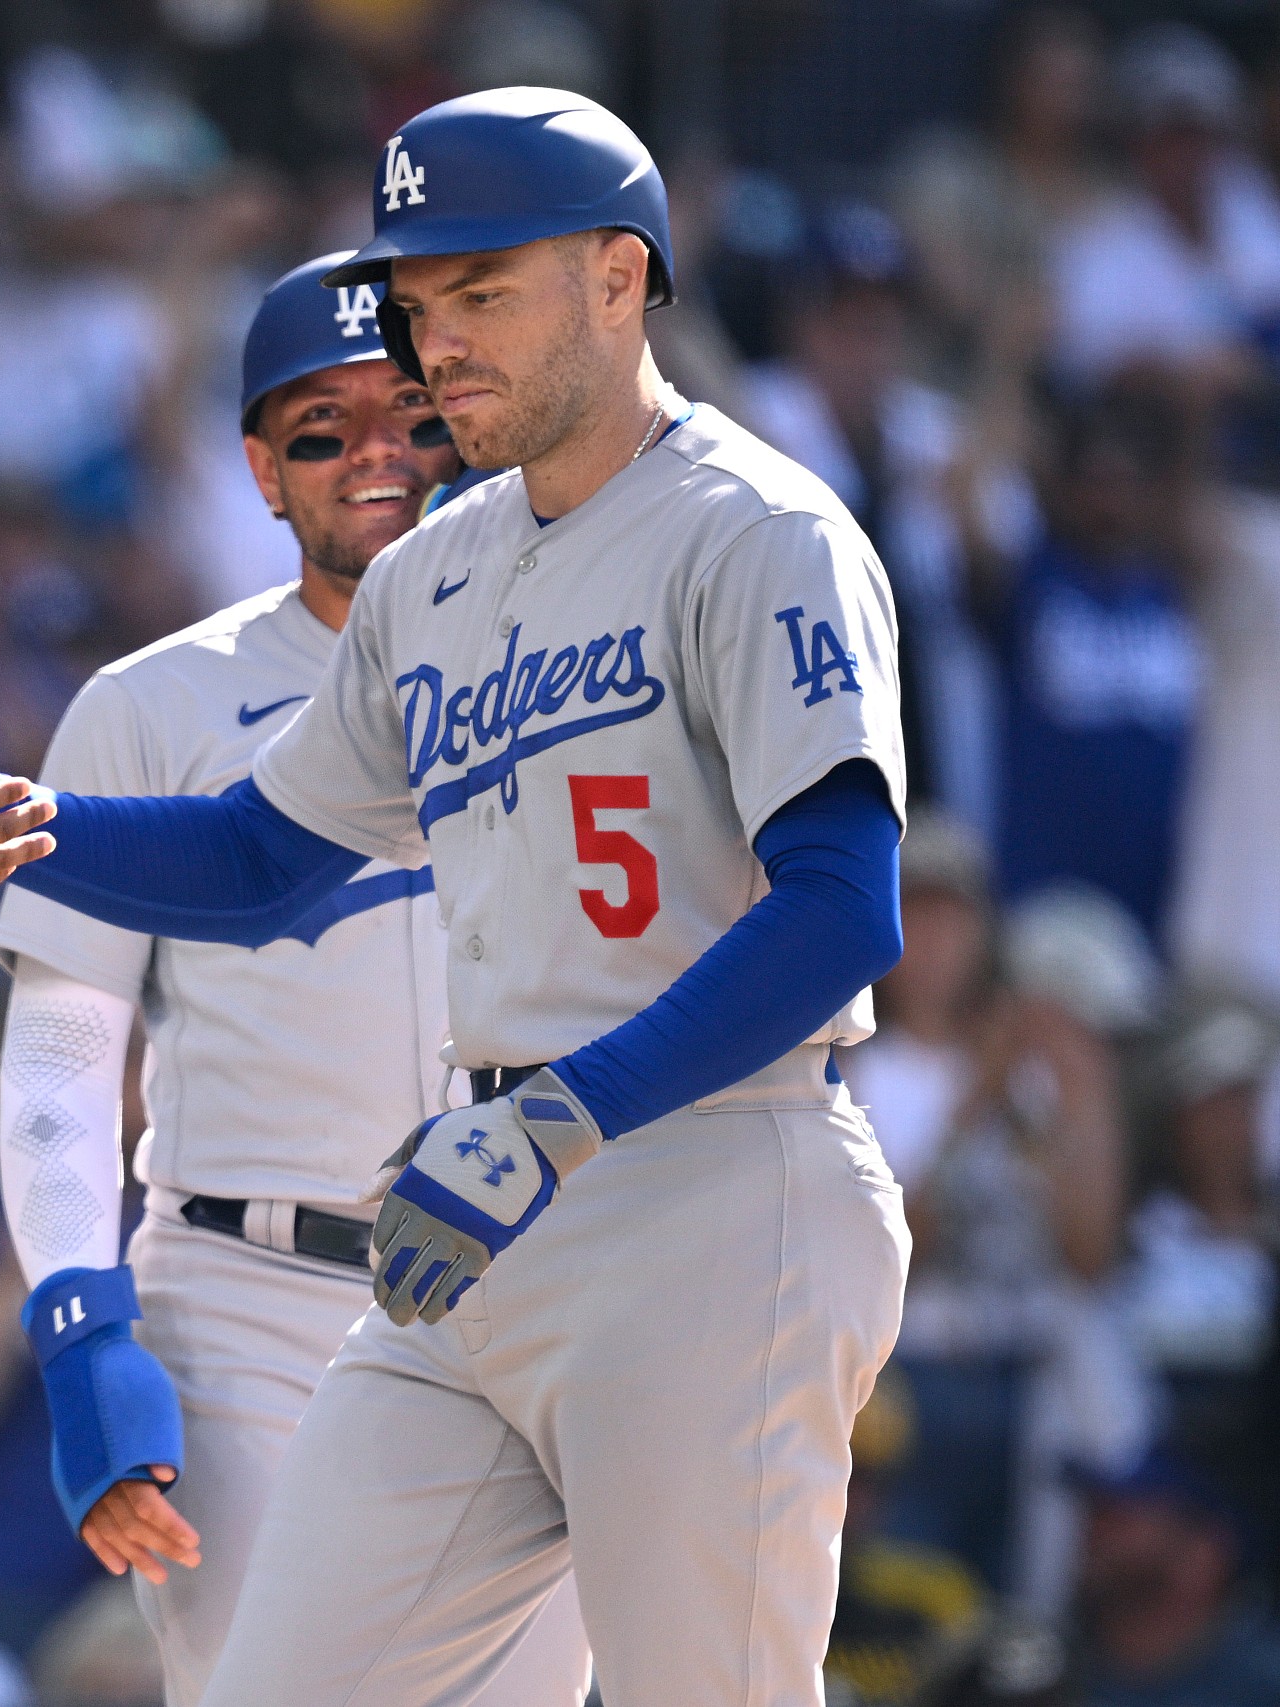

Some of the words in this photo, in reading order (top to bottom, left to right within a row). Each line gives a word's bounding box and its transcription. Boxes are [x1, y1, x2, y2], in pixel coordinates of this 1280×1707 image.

[382, 135, 426, 212] LA
[334, 283, 381, 337] LA
[774, 606, 864, 709] LA
[396, 621, 667, 815] Dodgers
[567, 774, 660, 939] 5
[53, 1296, 86, 1335] 11
